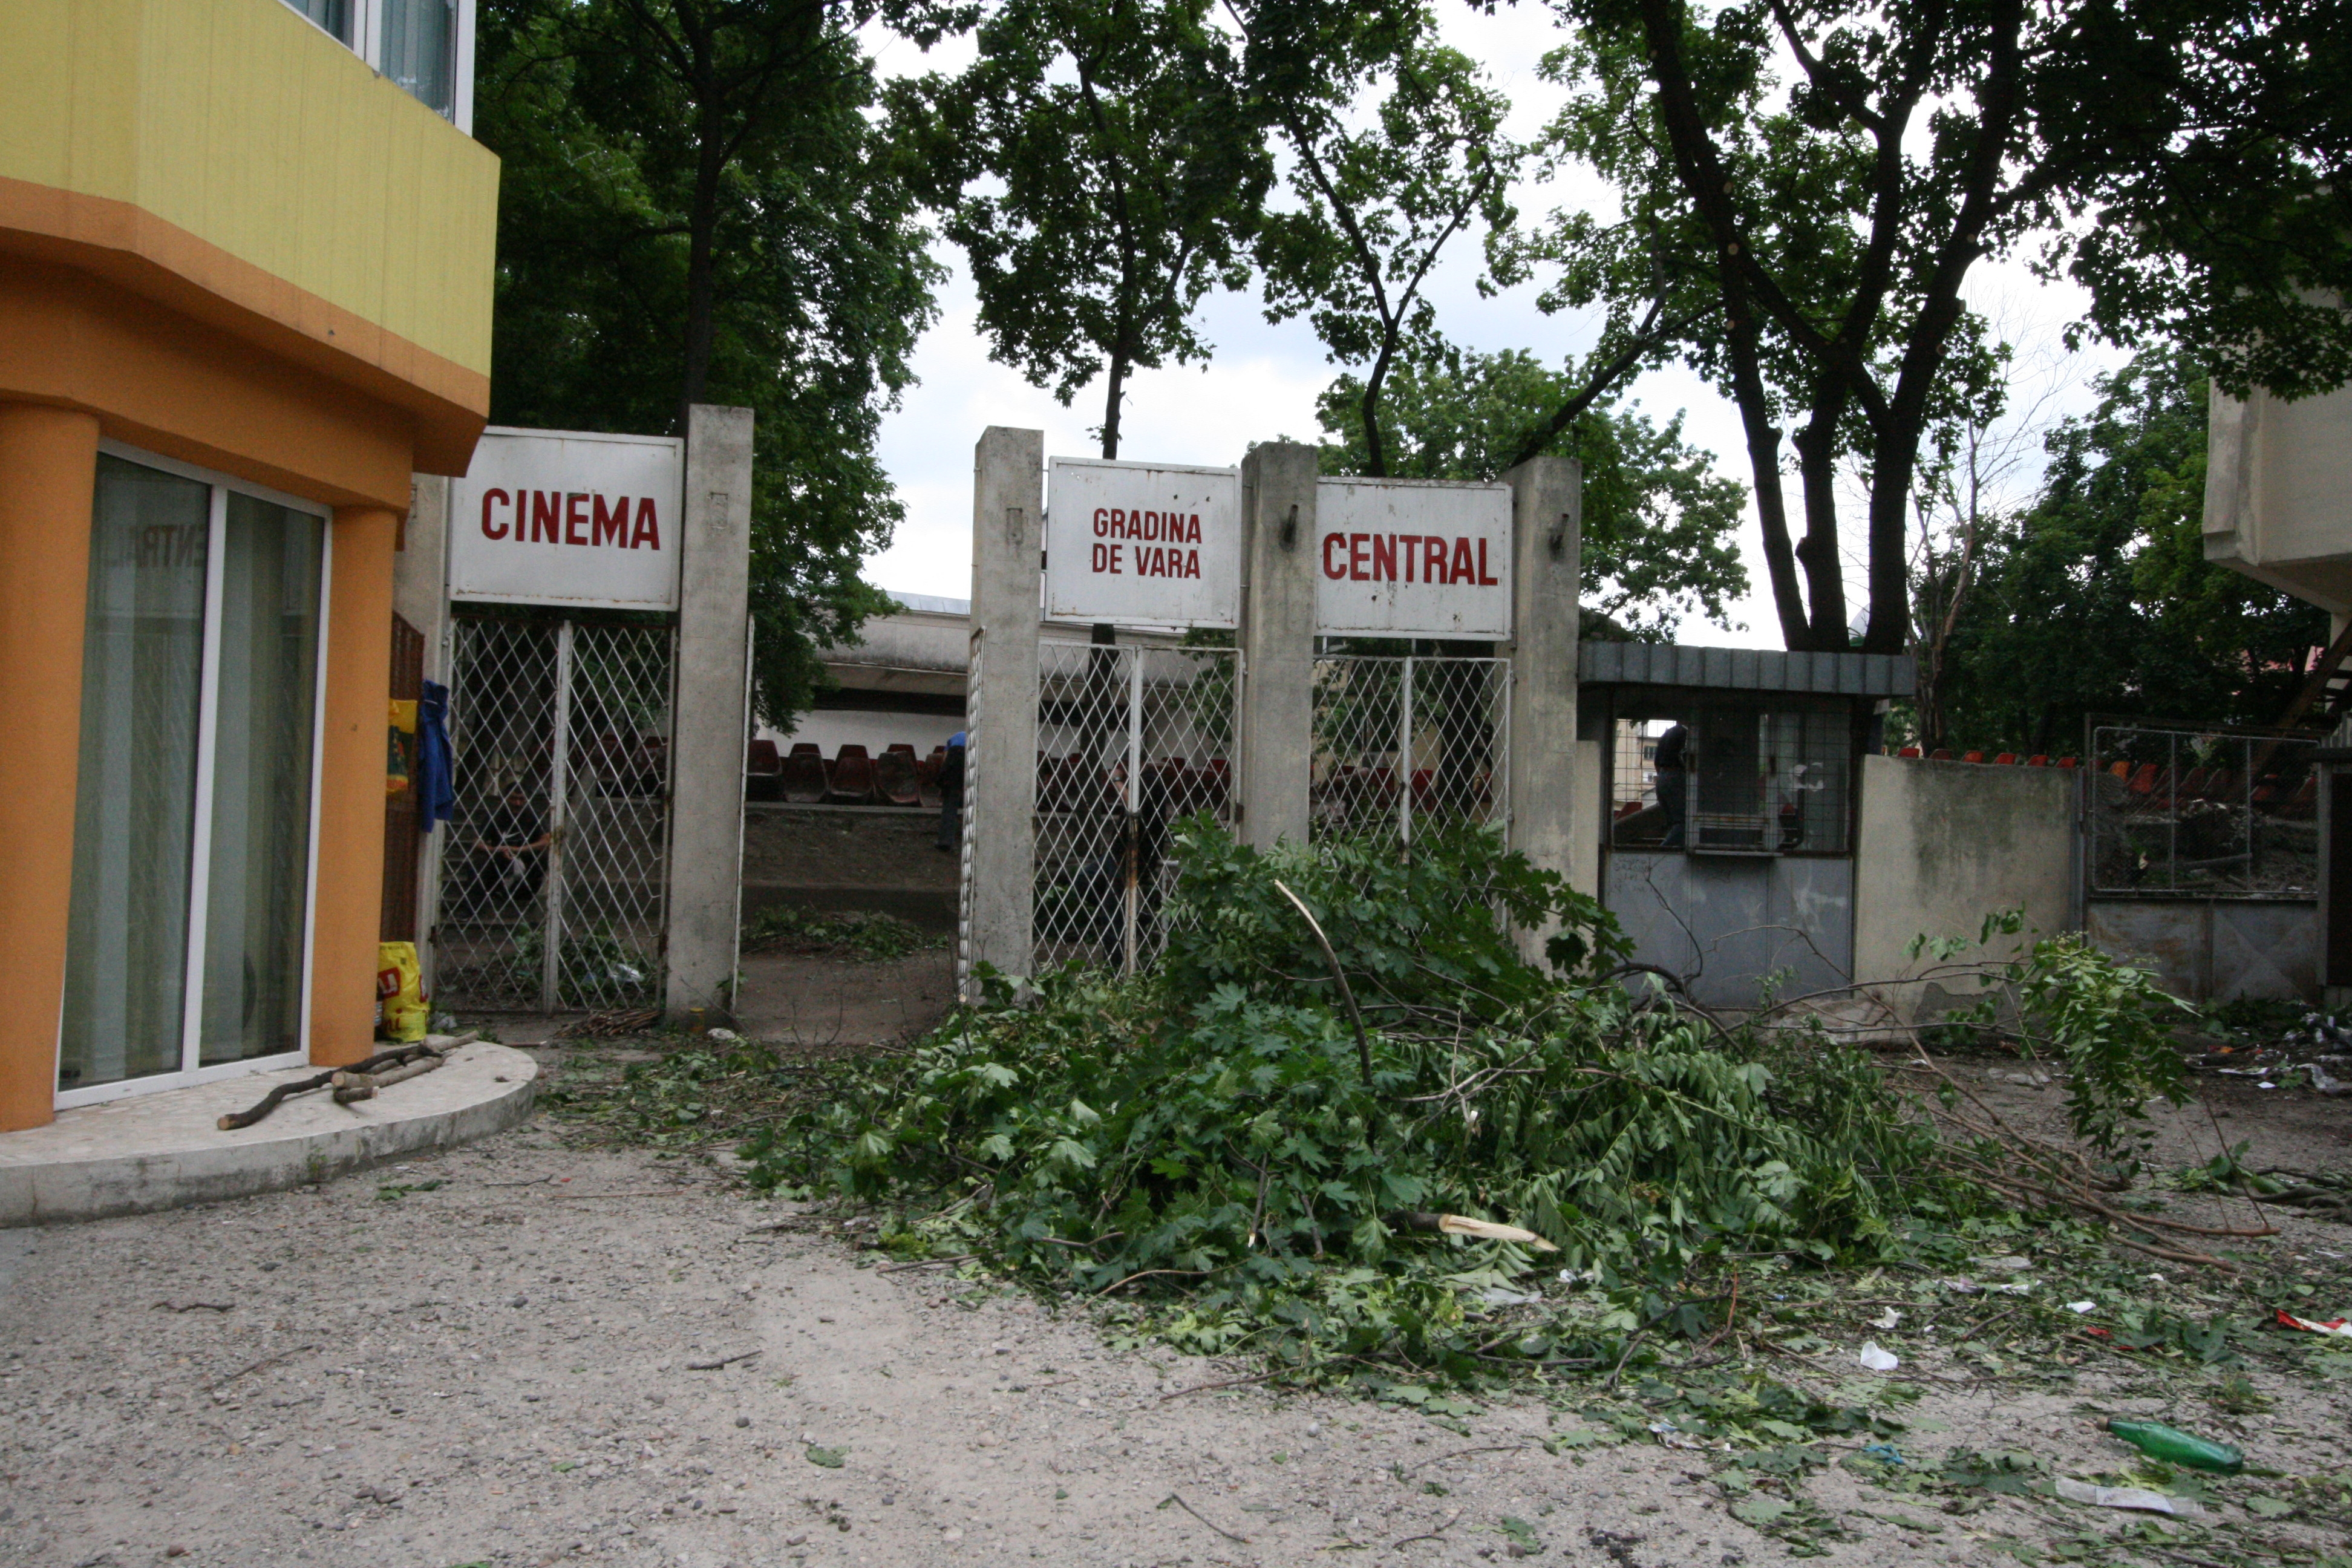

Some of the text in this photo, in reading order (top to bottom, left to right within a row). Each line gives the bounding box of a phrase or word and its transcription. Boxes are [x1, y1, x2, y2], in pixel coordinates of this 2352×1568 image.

[482, 488, 660, 550] CINEMA
[1093, 508, 1202, 543] GRADINA
[1093, 543, 1200, 579] DE VARA
[1323, 532, 1498, 586] CENTRAL
